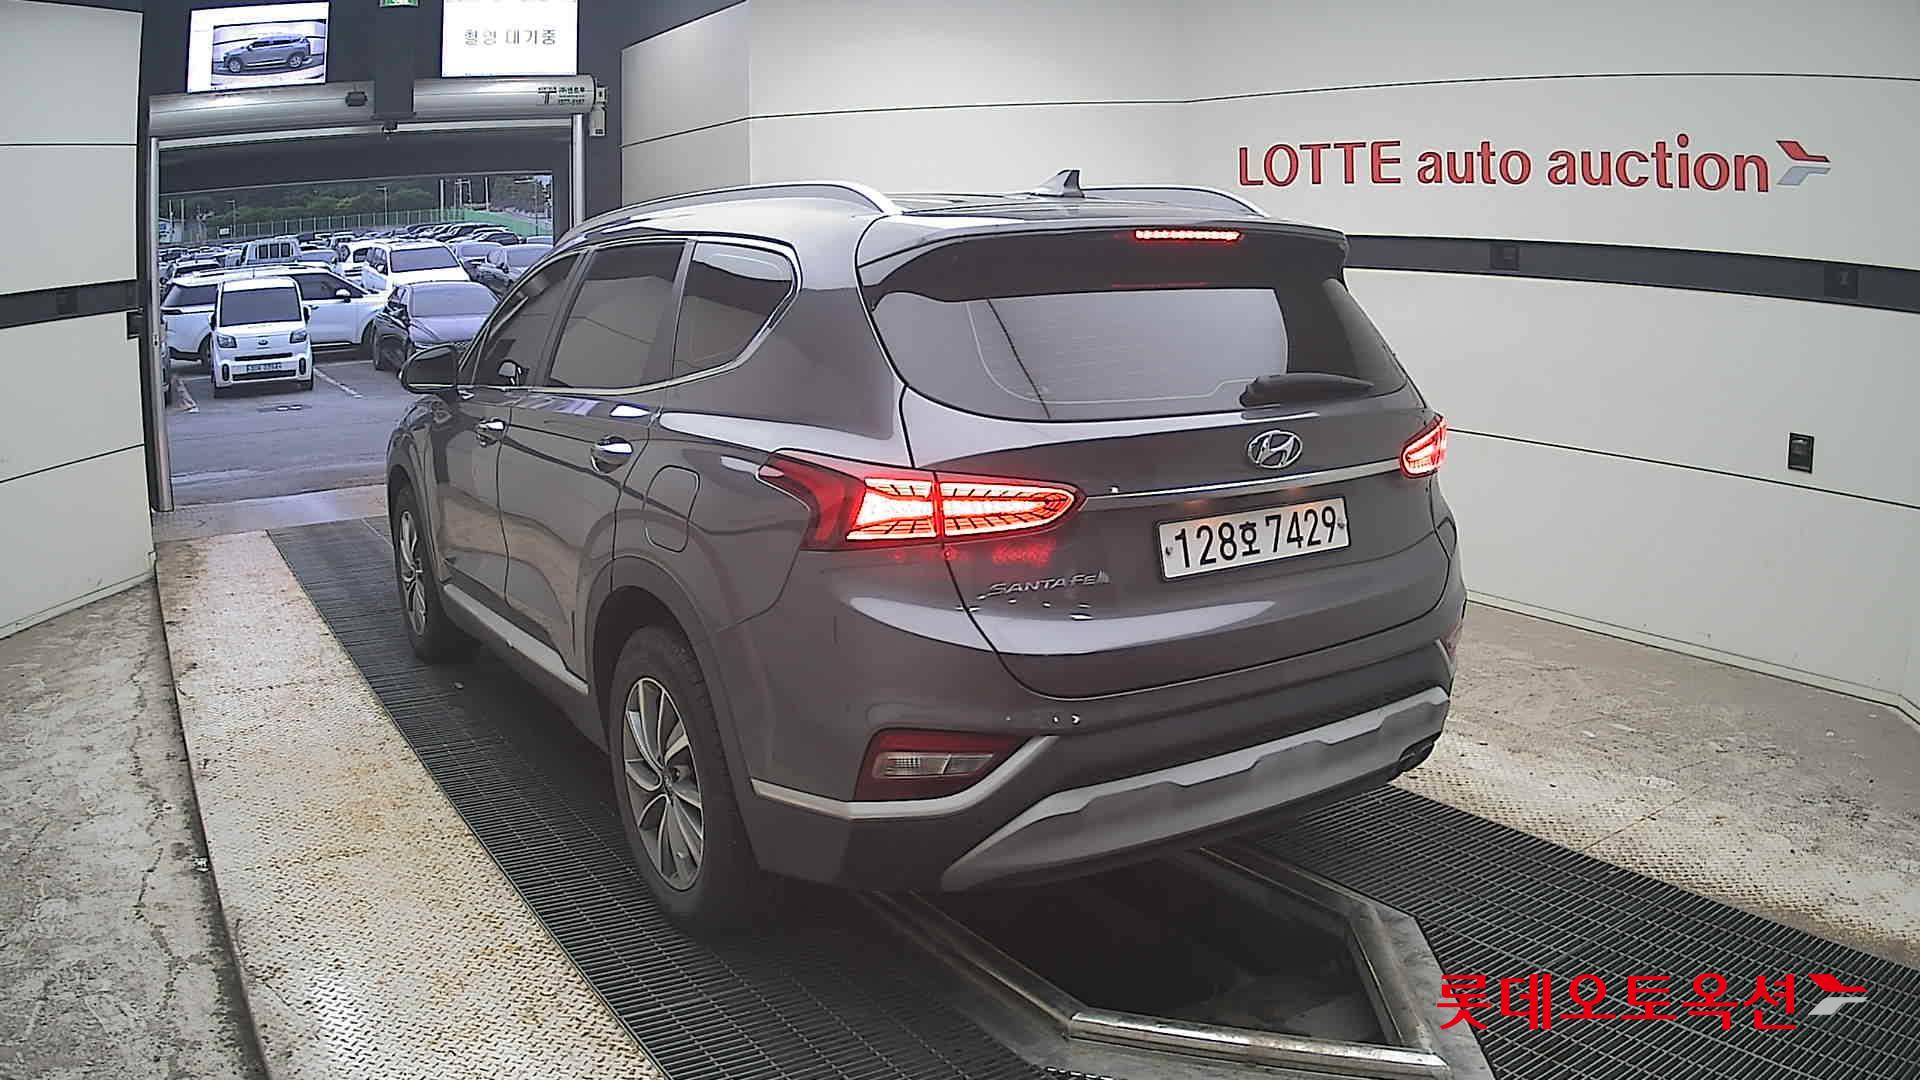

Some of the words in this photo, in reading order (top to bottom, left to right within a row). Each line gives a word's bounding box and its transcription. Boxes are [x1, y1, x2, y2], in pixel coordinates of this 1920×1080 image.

[504, 28, 556, 46] 대기중
[1239, 140, 1401, 187] LOTTE
[1417, 141, 1531, 185] auto
[1548, 134, 1769, 192] auction
[1265, 505, 1336, 553] 7429
